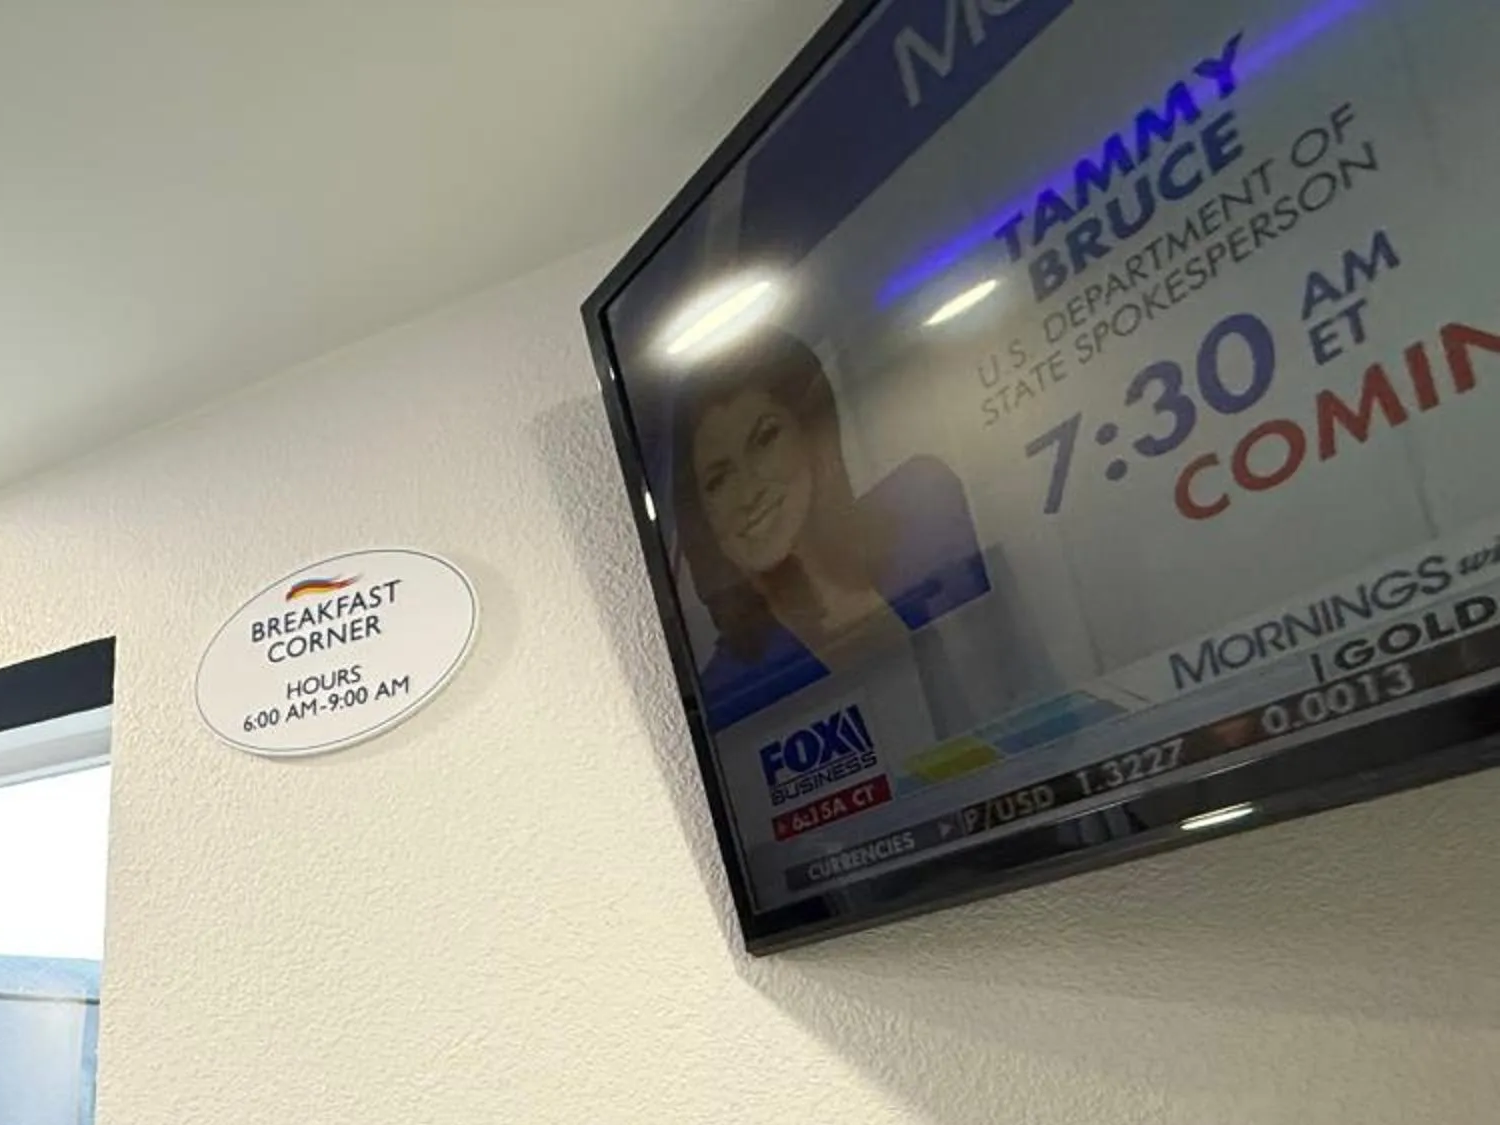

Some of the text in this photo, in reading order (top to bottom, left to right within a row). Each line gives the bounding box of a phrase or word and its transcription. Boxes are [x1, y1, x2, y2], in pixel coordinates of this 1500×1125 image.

[994, 30, 1244, 264] TAMMY
[976, 103, 1356, 390] U.S. DEPARTMENT OF
[1027, 110, 1244, 301] BRUCE
[981, 141, 1379, 427] STATE SPOKESPERSON
[1301, 230, 1400, 320] AM
[1309, 299, 1368, 366] ET
[1025, 312, 1276, 515] 7:30
[251, 579, 402, 642] BREAKFAST
[267, 615, 381, 663] CORNER
[1169, 555, 1452, 690] MORNINGS
[1334, 595, 1498, 671] GOLD
[242, 708, 280, 732] 6:00
[375, 676, 410, 700] AM
[286, 665, 361, 699] HOURS
[760, 705, 874, 786] FOX
[771, 751, 878, 807] BUSINESS
[807, 832, 915, 881] CURRENCIES
[1077, 738, 1186, 795] 1.3227
[1261, 663, 1414, 735] 0.0013
